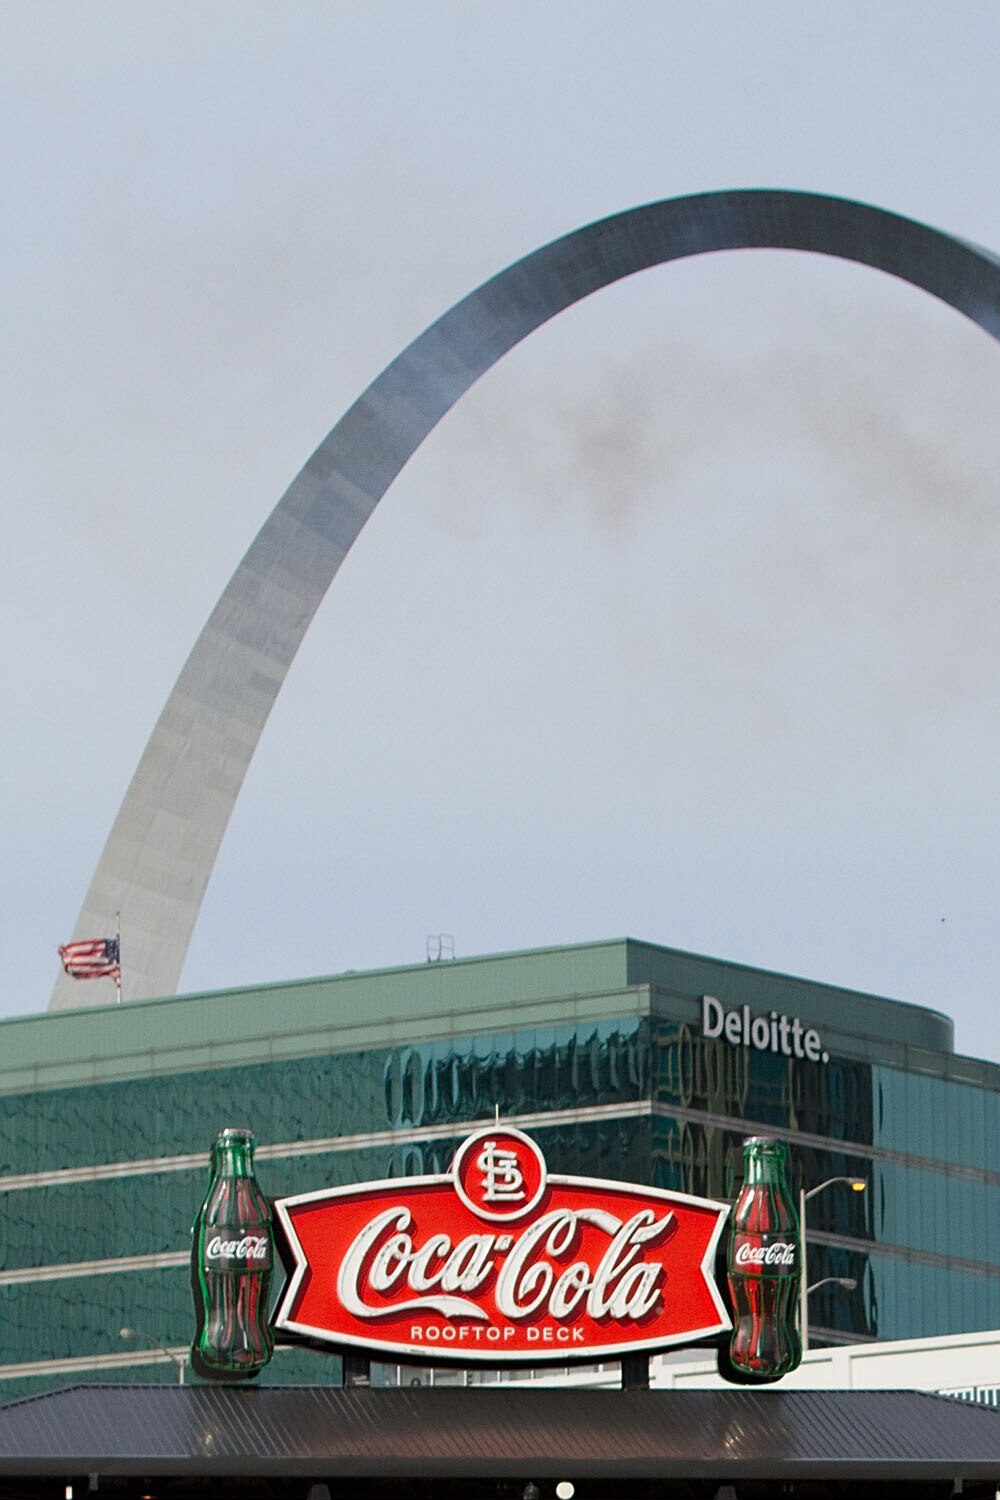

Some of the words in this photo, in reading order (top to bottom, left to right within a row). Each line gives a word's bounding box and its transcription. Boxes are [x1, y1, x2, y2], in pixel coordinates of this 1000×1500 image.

[206, 1236, 268, 1259] Coca-Cola
[735, 1242, 796, 1265] Coca-Cola
[337, 1206, 673, 1320] Coca-Cola
[410, 1326, 516, 1342] ROOFTOP
[527, 1326, 585, 1342] DECK
